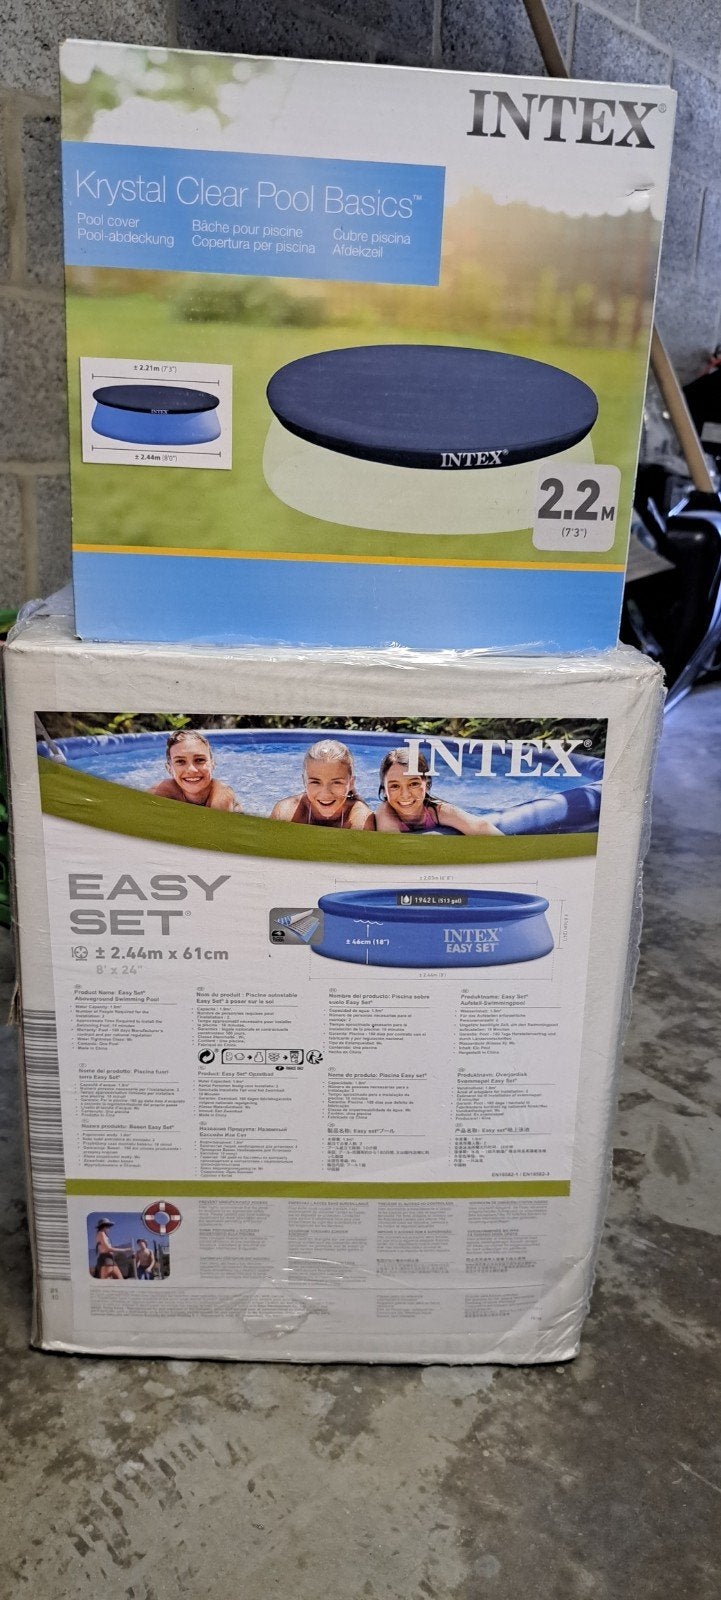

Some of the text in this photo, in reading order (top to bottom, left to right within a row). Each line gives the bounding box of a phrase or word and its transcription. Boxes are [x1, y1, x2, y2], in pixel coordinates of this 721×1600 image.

[75, 169, 166, 206] Krystal
[176, 175, 249, 208] Clear
[257, 181, 314, 212] Pool
[77, 212, 140, 228] Pool cover
[77, 228, 175, 249] Pool-abdeckung
[192, 219, 303, 241] Bâche pour piscine
[333, 228, 411, 247] Cubre piscina
[192, 235, 315, 255] Copertura per piscina
[332, 245, 384, 259] Afdekzeil
[68, 873, 232, 901] EASY
[111, 946, 163, 960] 2.44m
[168, 950, 178, 960] x
[183, 947, 229, 960] 61cm
[446, 943, 496, 953] EASY SET
[110, 967, 118, 975] x
